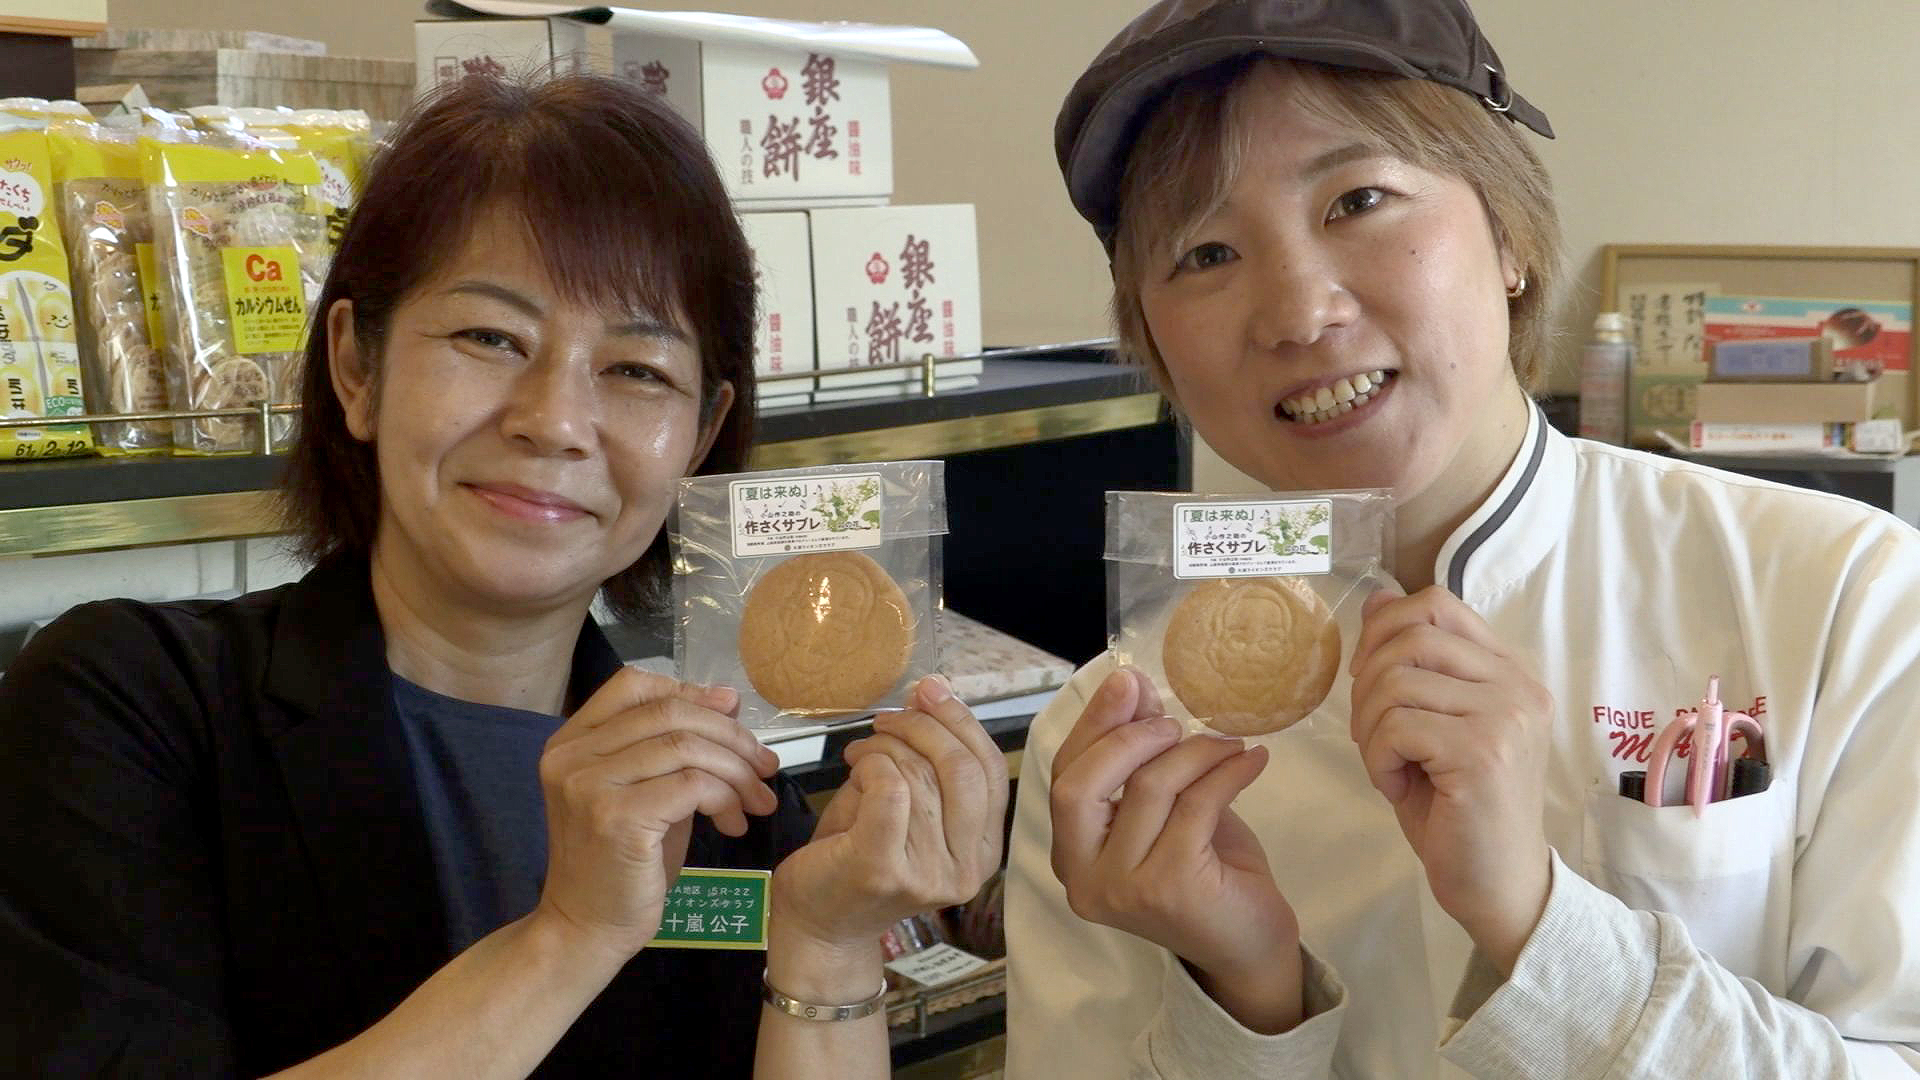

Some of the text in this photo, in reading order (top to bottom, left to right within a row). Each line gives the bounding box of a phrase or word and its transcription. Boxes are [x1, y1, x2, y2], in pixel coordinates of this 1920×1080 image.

[245, 253, 282, 282] Ca
[235, 296, 301, 315] カルシウムせん
[740, 484, 808, 501] 「夏は来ぬ」
[1183, 508, 1255, 523] 「夏は来ぬ」
[744, 517, 820, 535] 作さくサブレ
[1186, 539, 1267, 556] 作さくサブレ
[1593, 706, 1655, 730] FIGUE
[659, 912, 750, 935] 十嵐 公子
